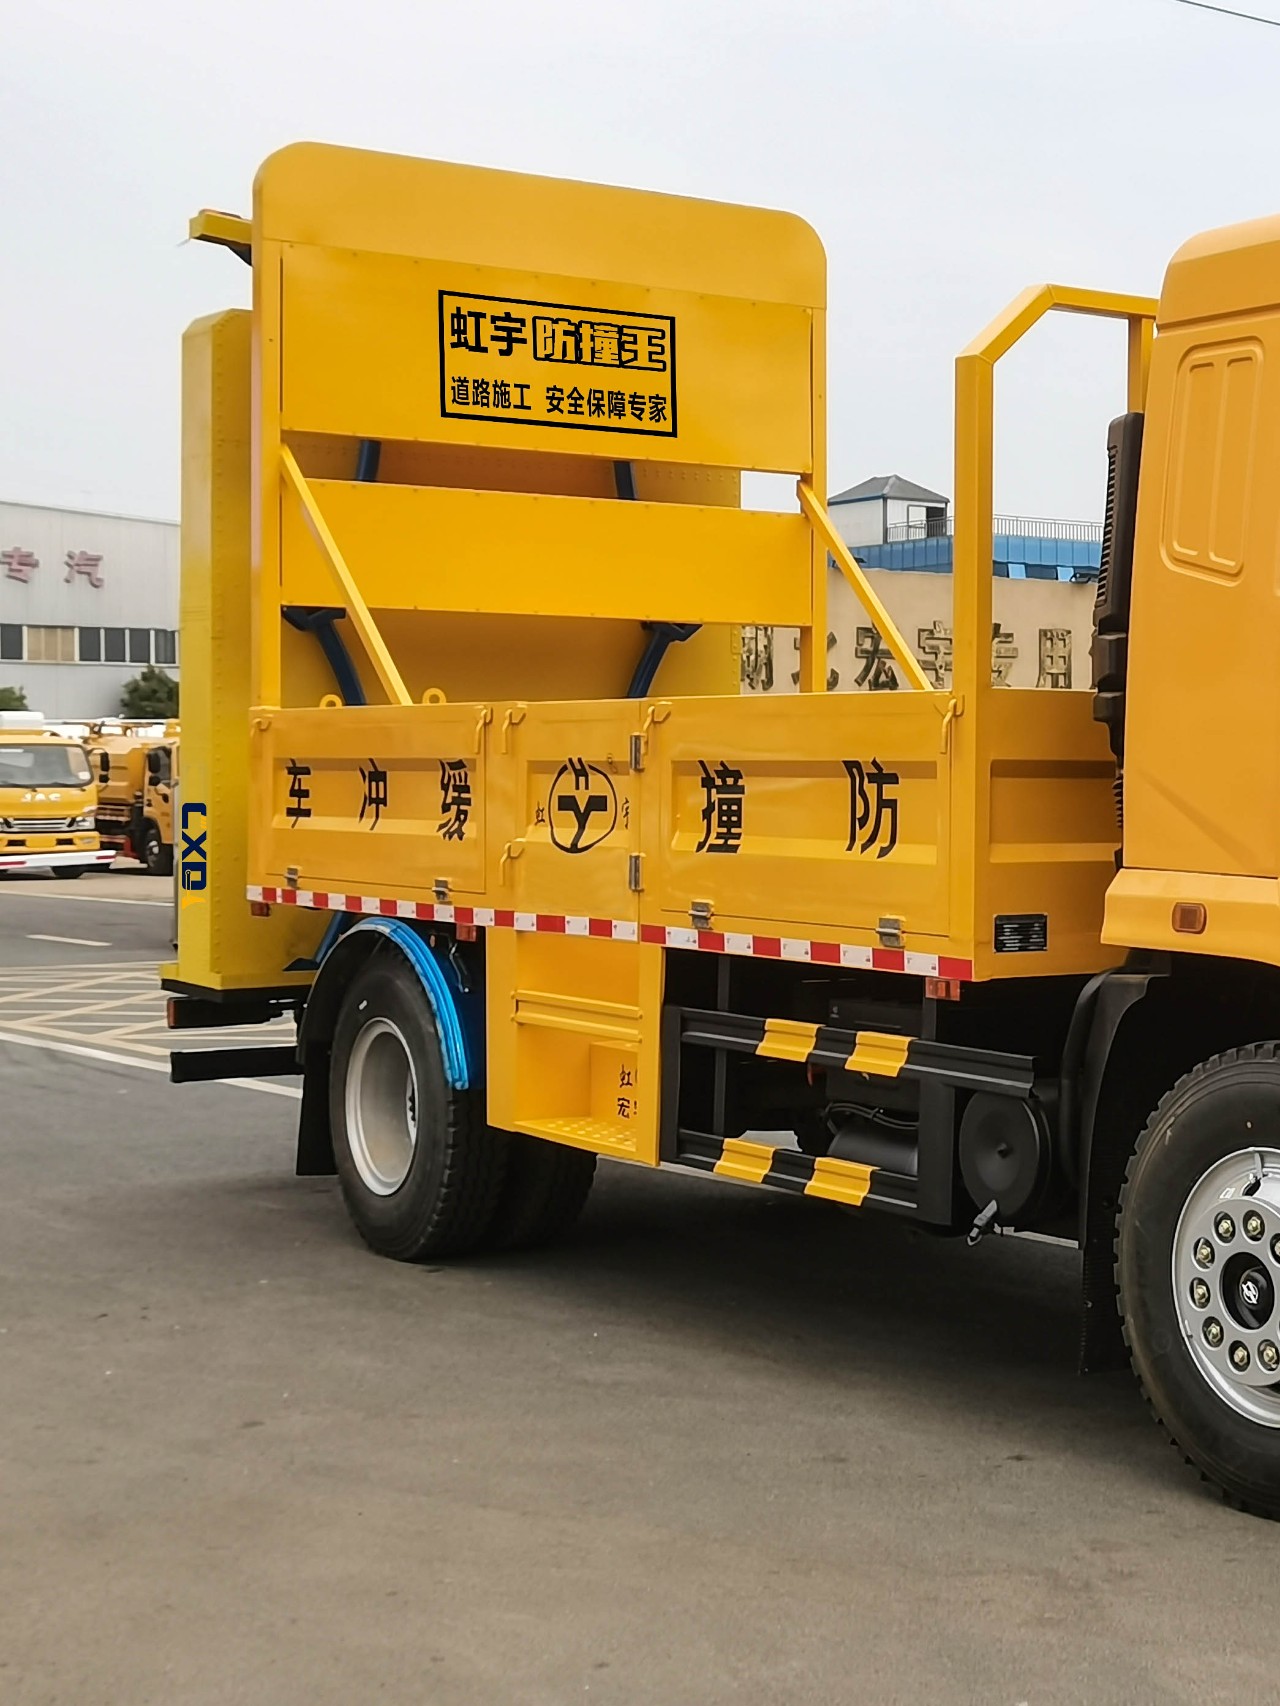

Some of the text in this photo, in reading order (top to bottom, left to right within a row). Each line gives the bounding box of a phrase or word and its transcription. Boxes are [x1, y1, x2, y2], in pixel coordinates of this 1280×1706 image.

[451, 376, 668, 423] 道路施工 安全保障专家
